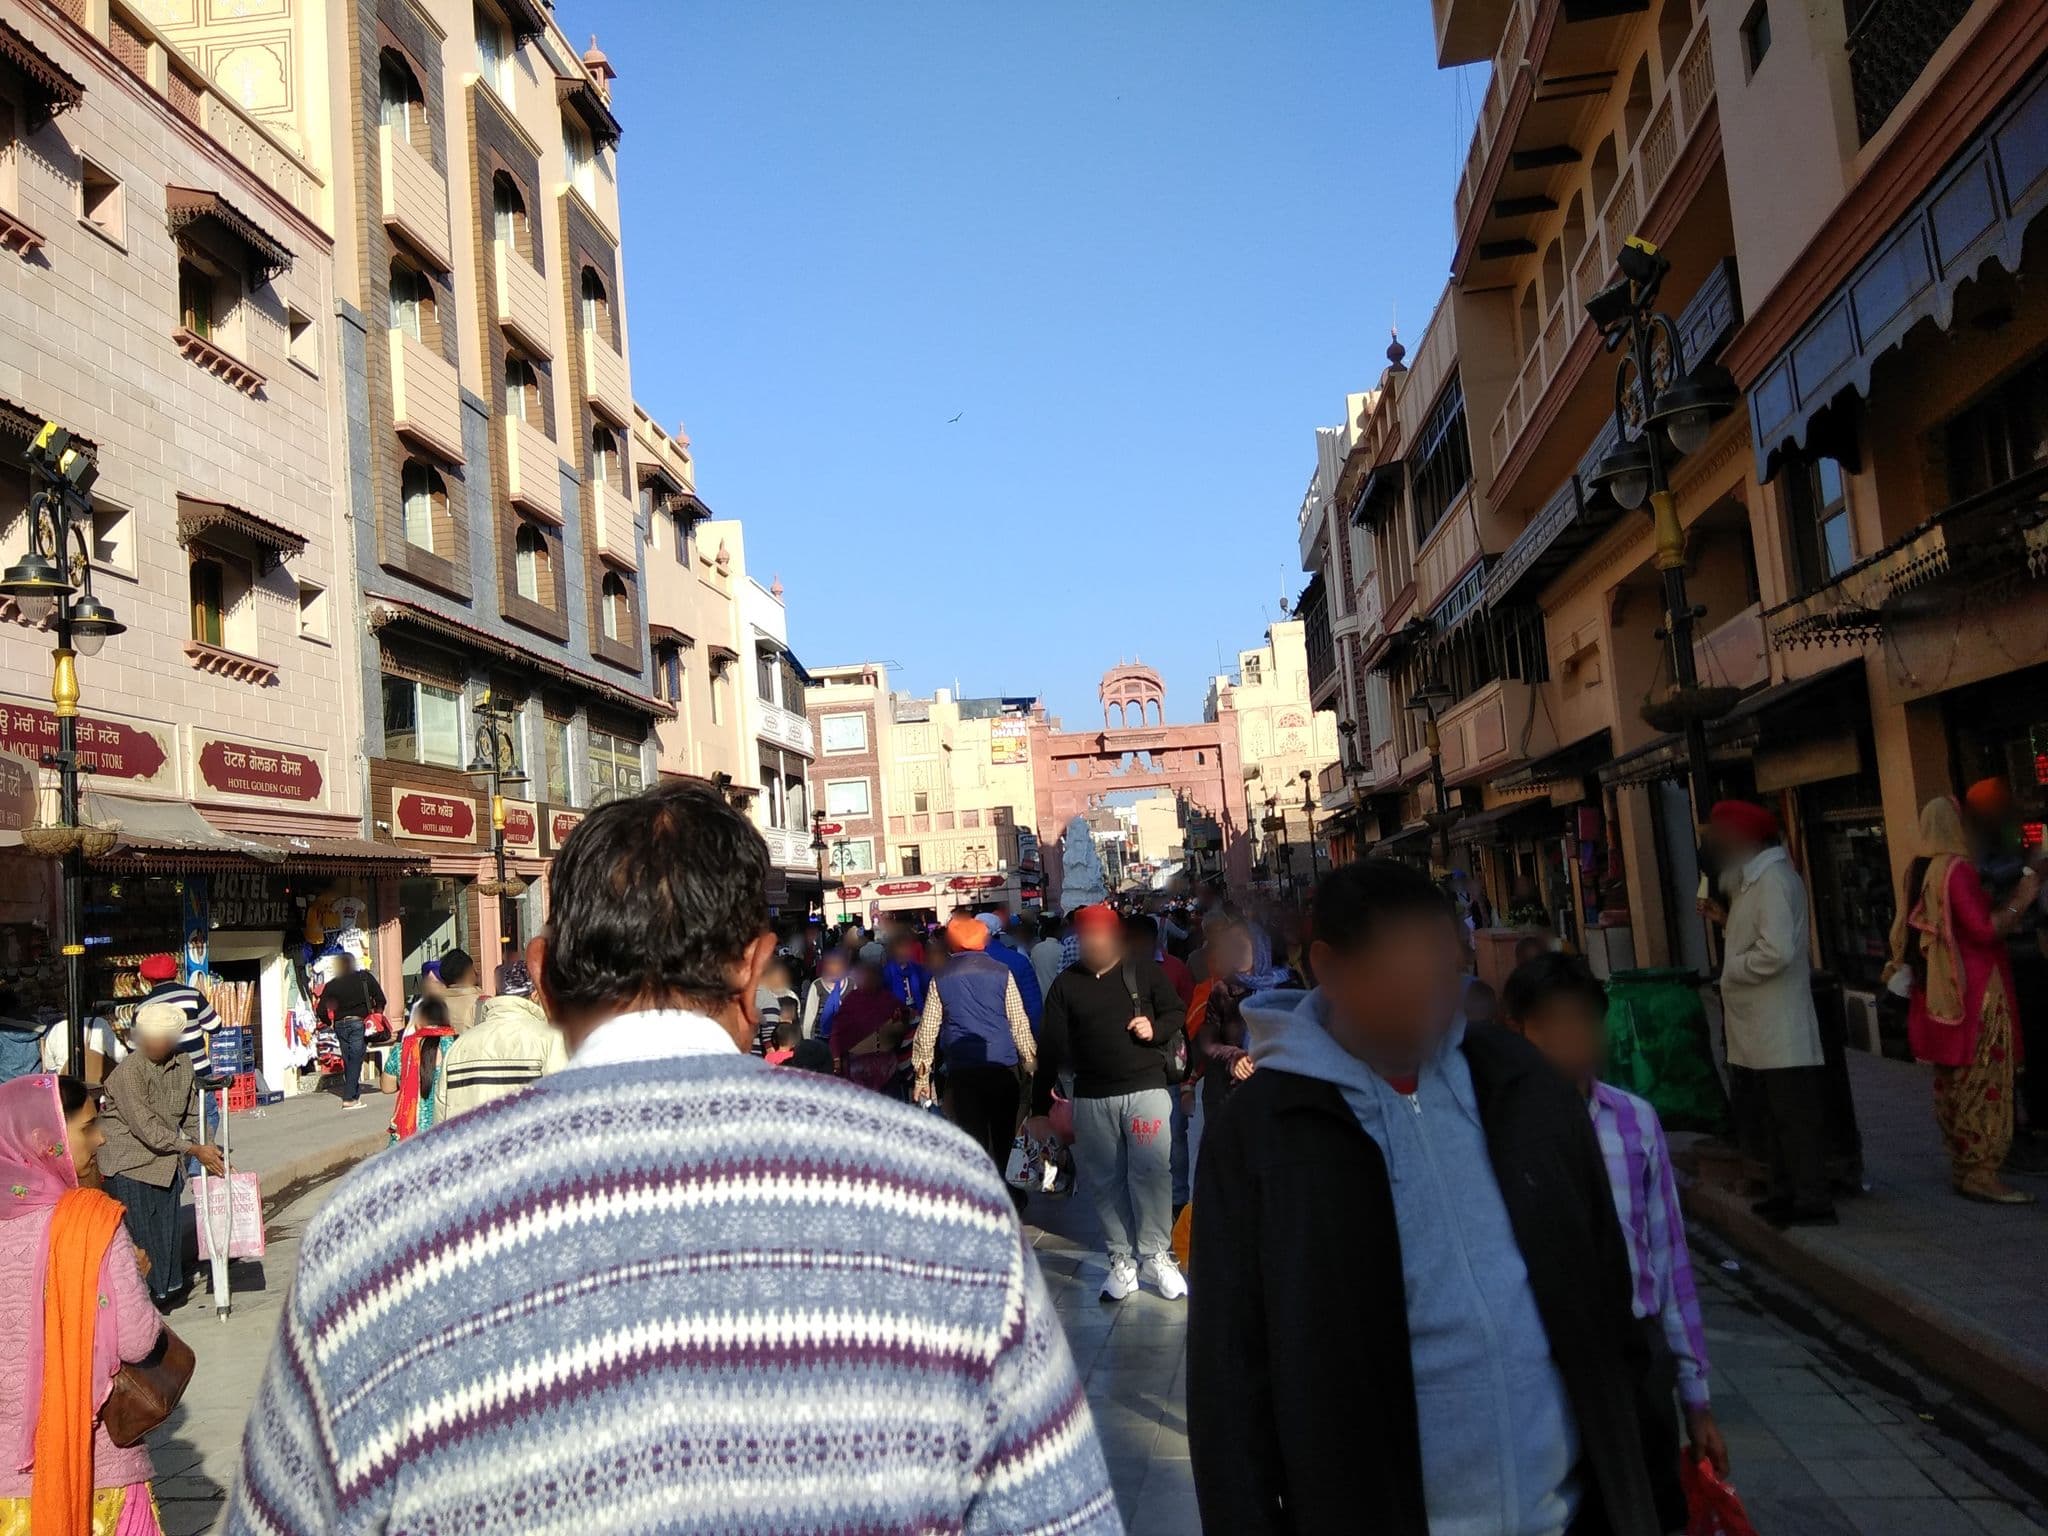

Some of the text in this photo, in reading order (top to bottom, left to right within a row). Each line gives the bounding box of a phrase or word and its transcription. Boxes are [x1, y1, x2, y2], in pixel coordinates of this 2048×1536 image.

[13, 710, 35, 734] ਮੋਚੀ
[39, 716, 60, 737] ਪੰਜਾ
[98, 725, 120, 745] ਸਟੋਰ
[9, 740, 39, 760] MOCHI
[101, 753, 124, 770] STORE
[223, 744, 246, 768] ਹੋਟਲ
[227, 778, 301, 795] HOTEL GOLDEN CASTLE
[422, 823, 438, 832] HOTEL
[214, 873, 270, 899] HOTEL
[1131, 1118, 1161, 1135] A&F
